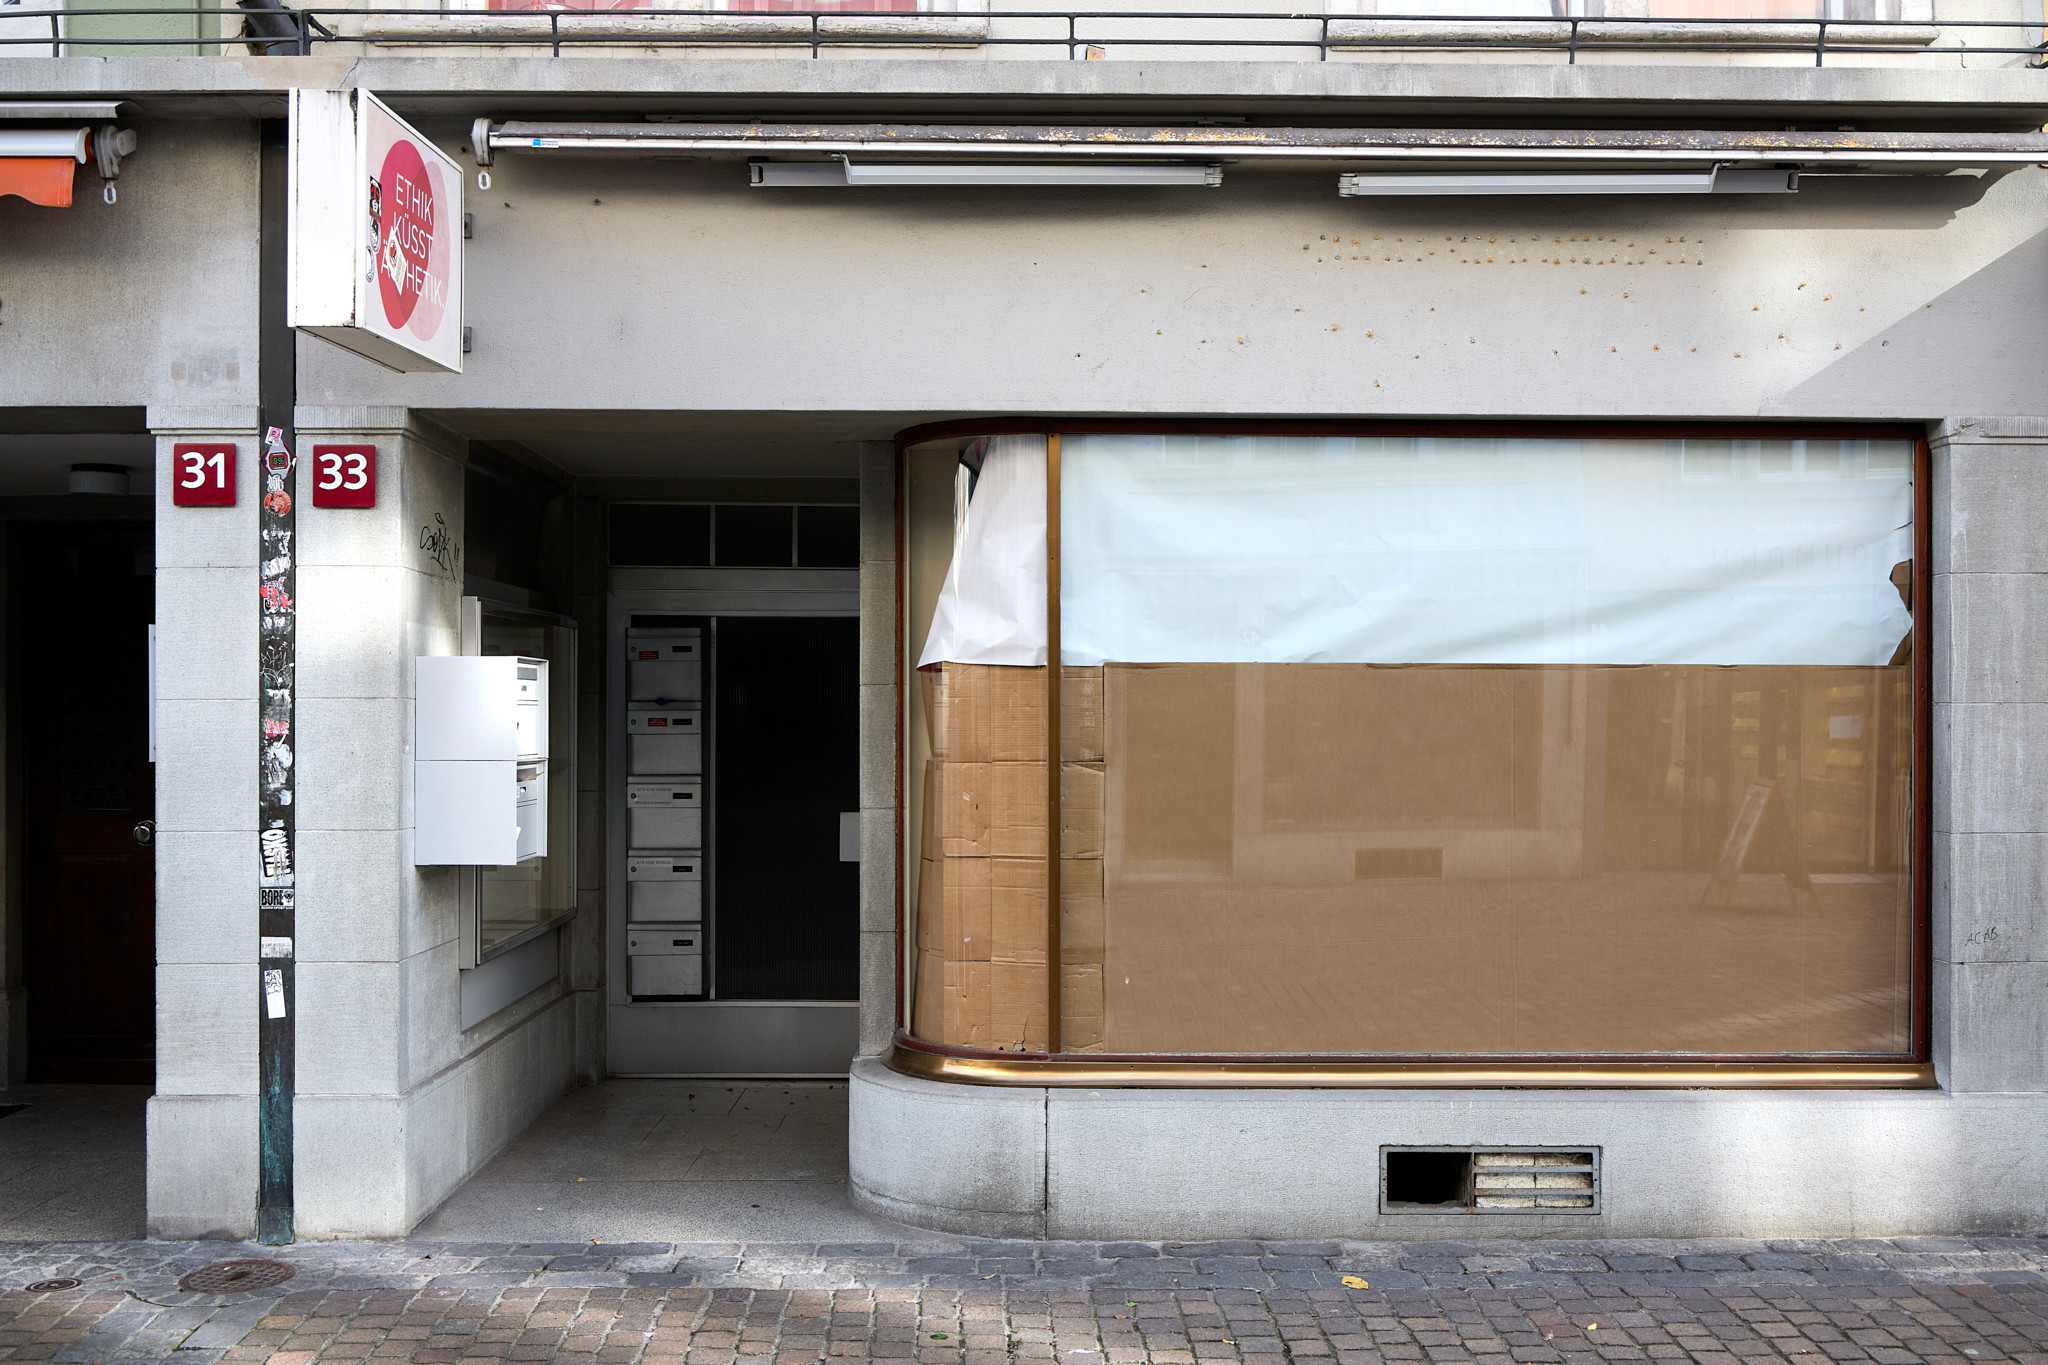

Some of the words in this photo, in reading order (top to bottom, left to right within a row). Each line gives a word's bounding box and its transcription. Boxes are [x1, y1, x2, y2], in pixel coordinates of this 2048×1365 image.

[396, 173, 433, 226] ETHIK
[393, 211, 433, 263] KÜSST
[380, 239, 445, 308] ÄHETIK.
[180, 451, 226, 489] 31
[318, 453, 369, 490] 33
[261, 889, 284, 906] BORE
